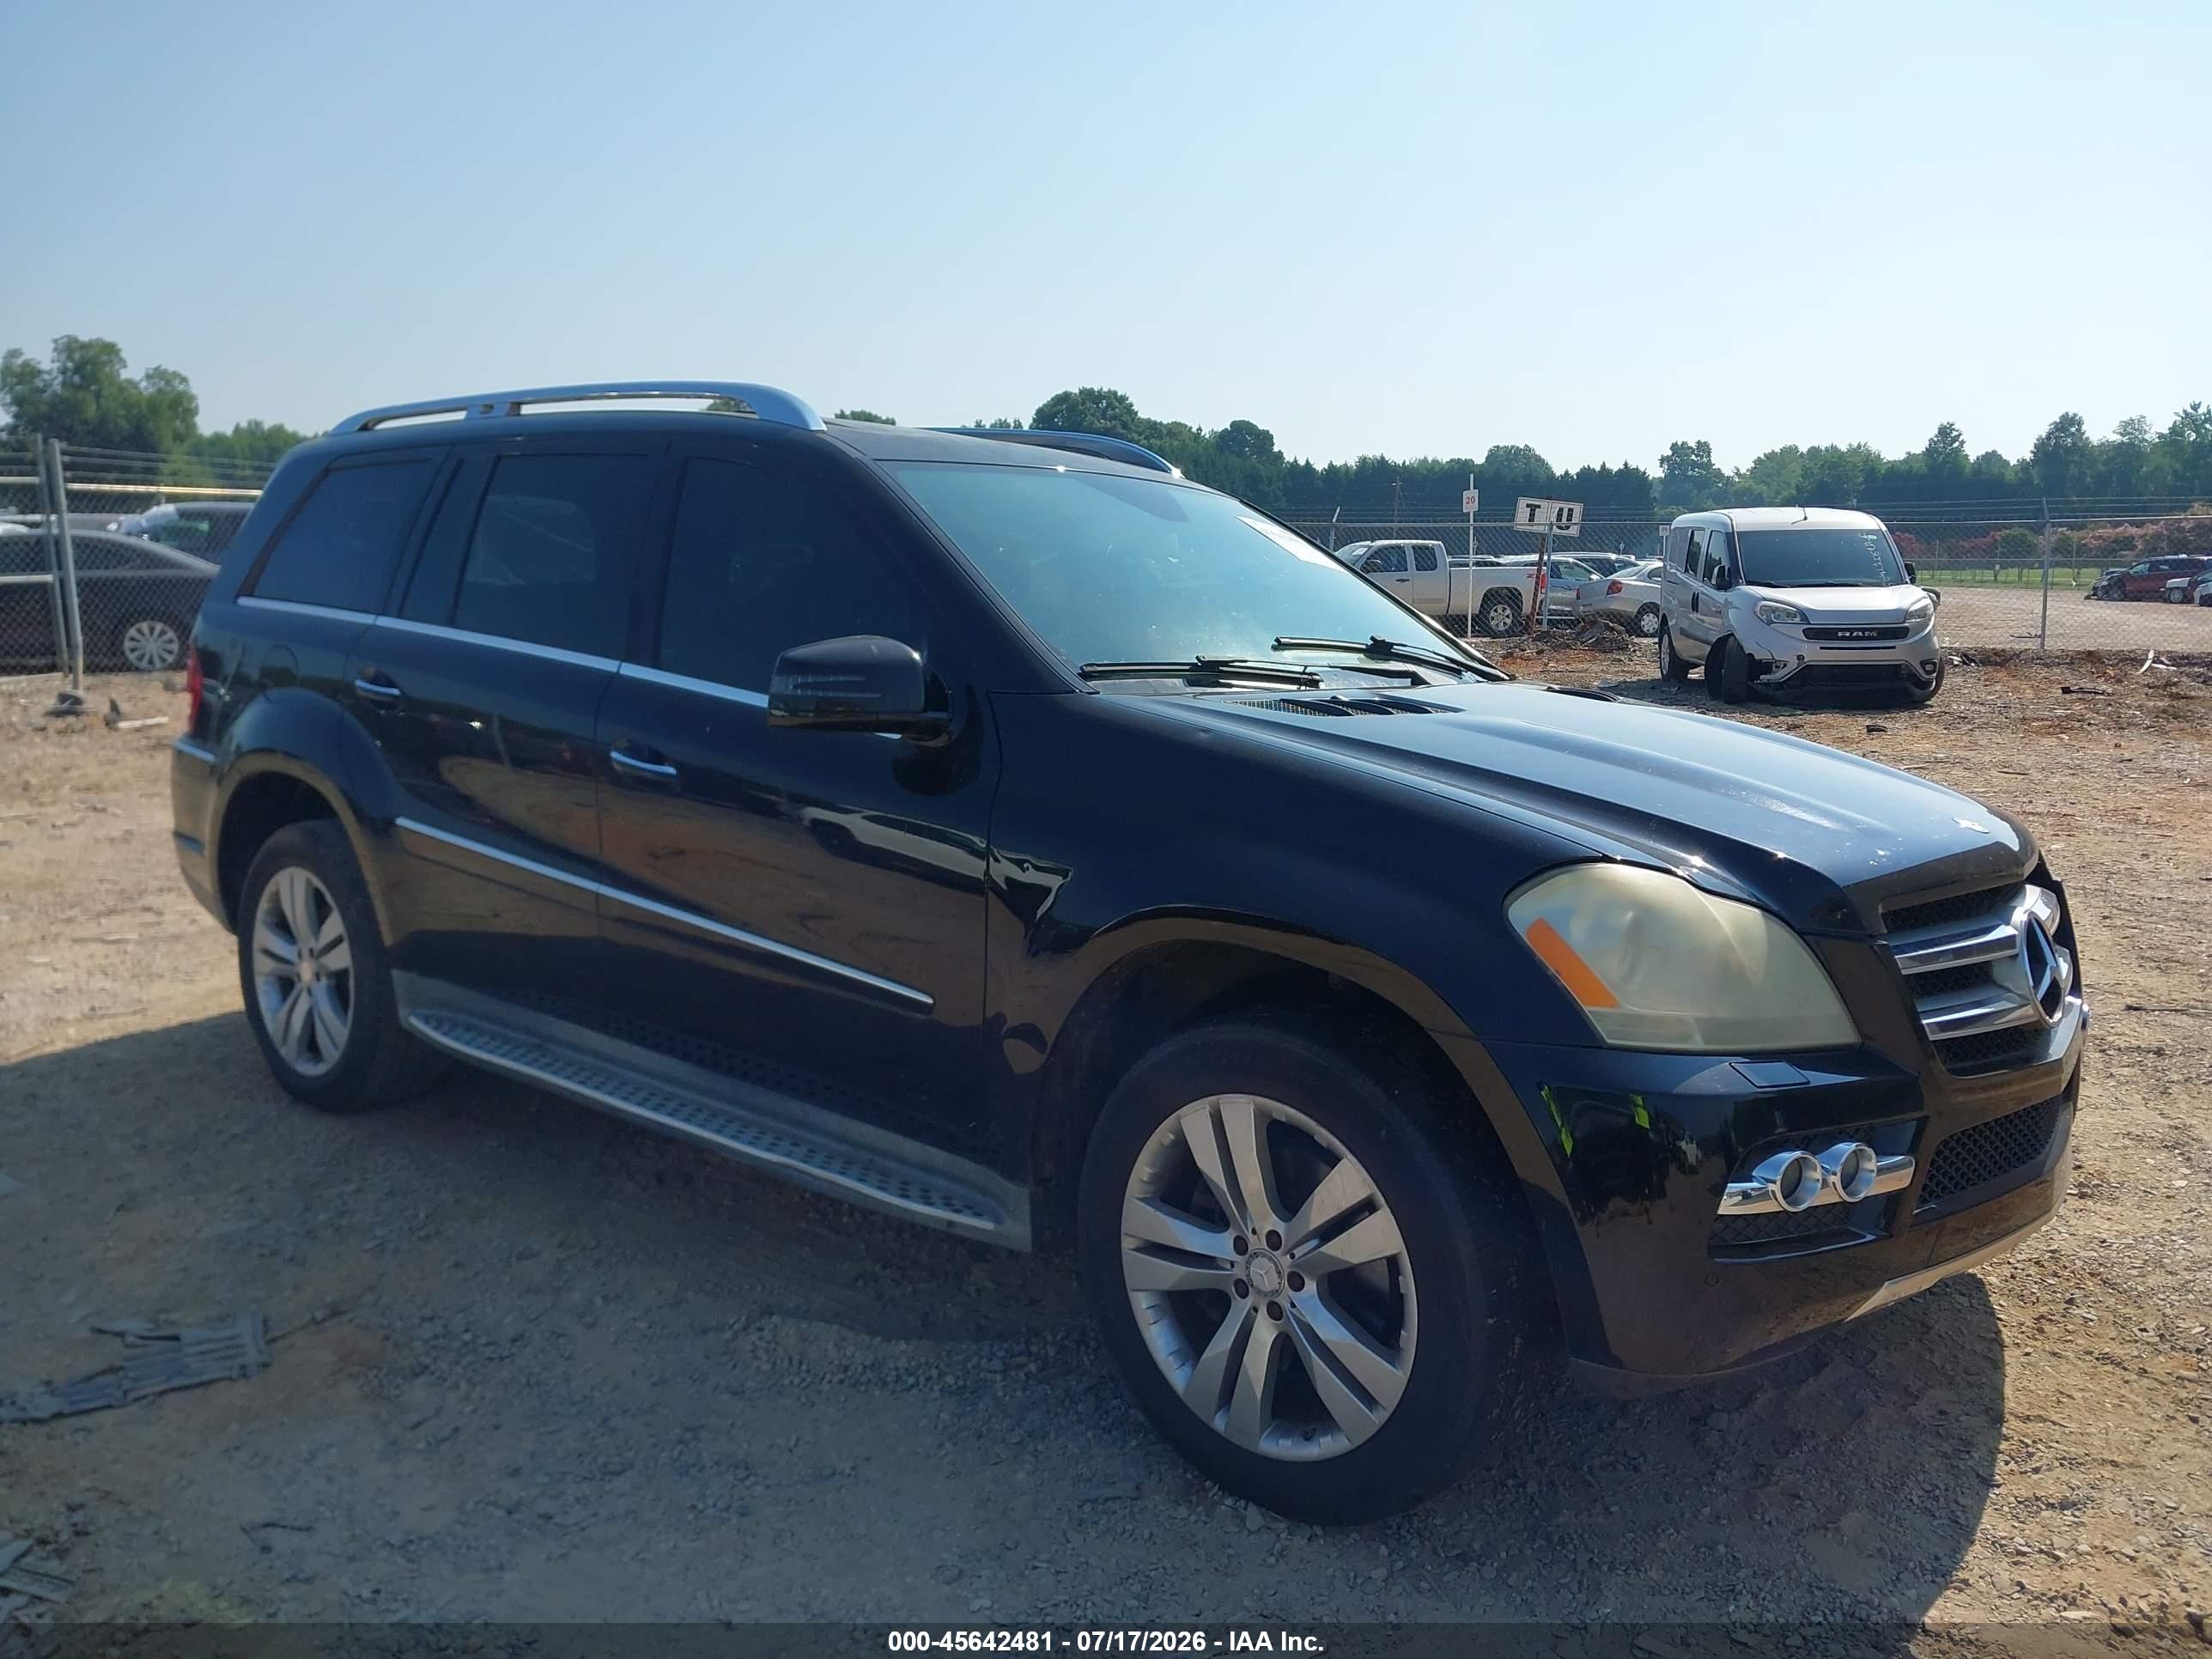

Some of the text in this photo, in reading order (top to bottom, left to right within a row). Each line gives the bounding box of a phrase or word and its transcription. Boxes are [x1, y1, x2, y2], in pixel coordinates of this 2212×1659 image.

[1466, 495, 1475, 504] 20
[1526, 503, 1574, 530] T U
